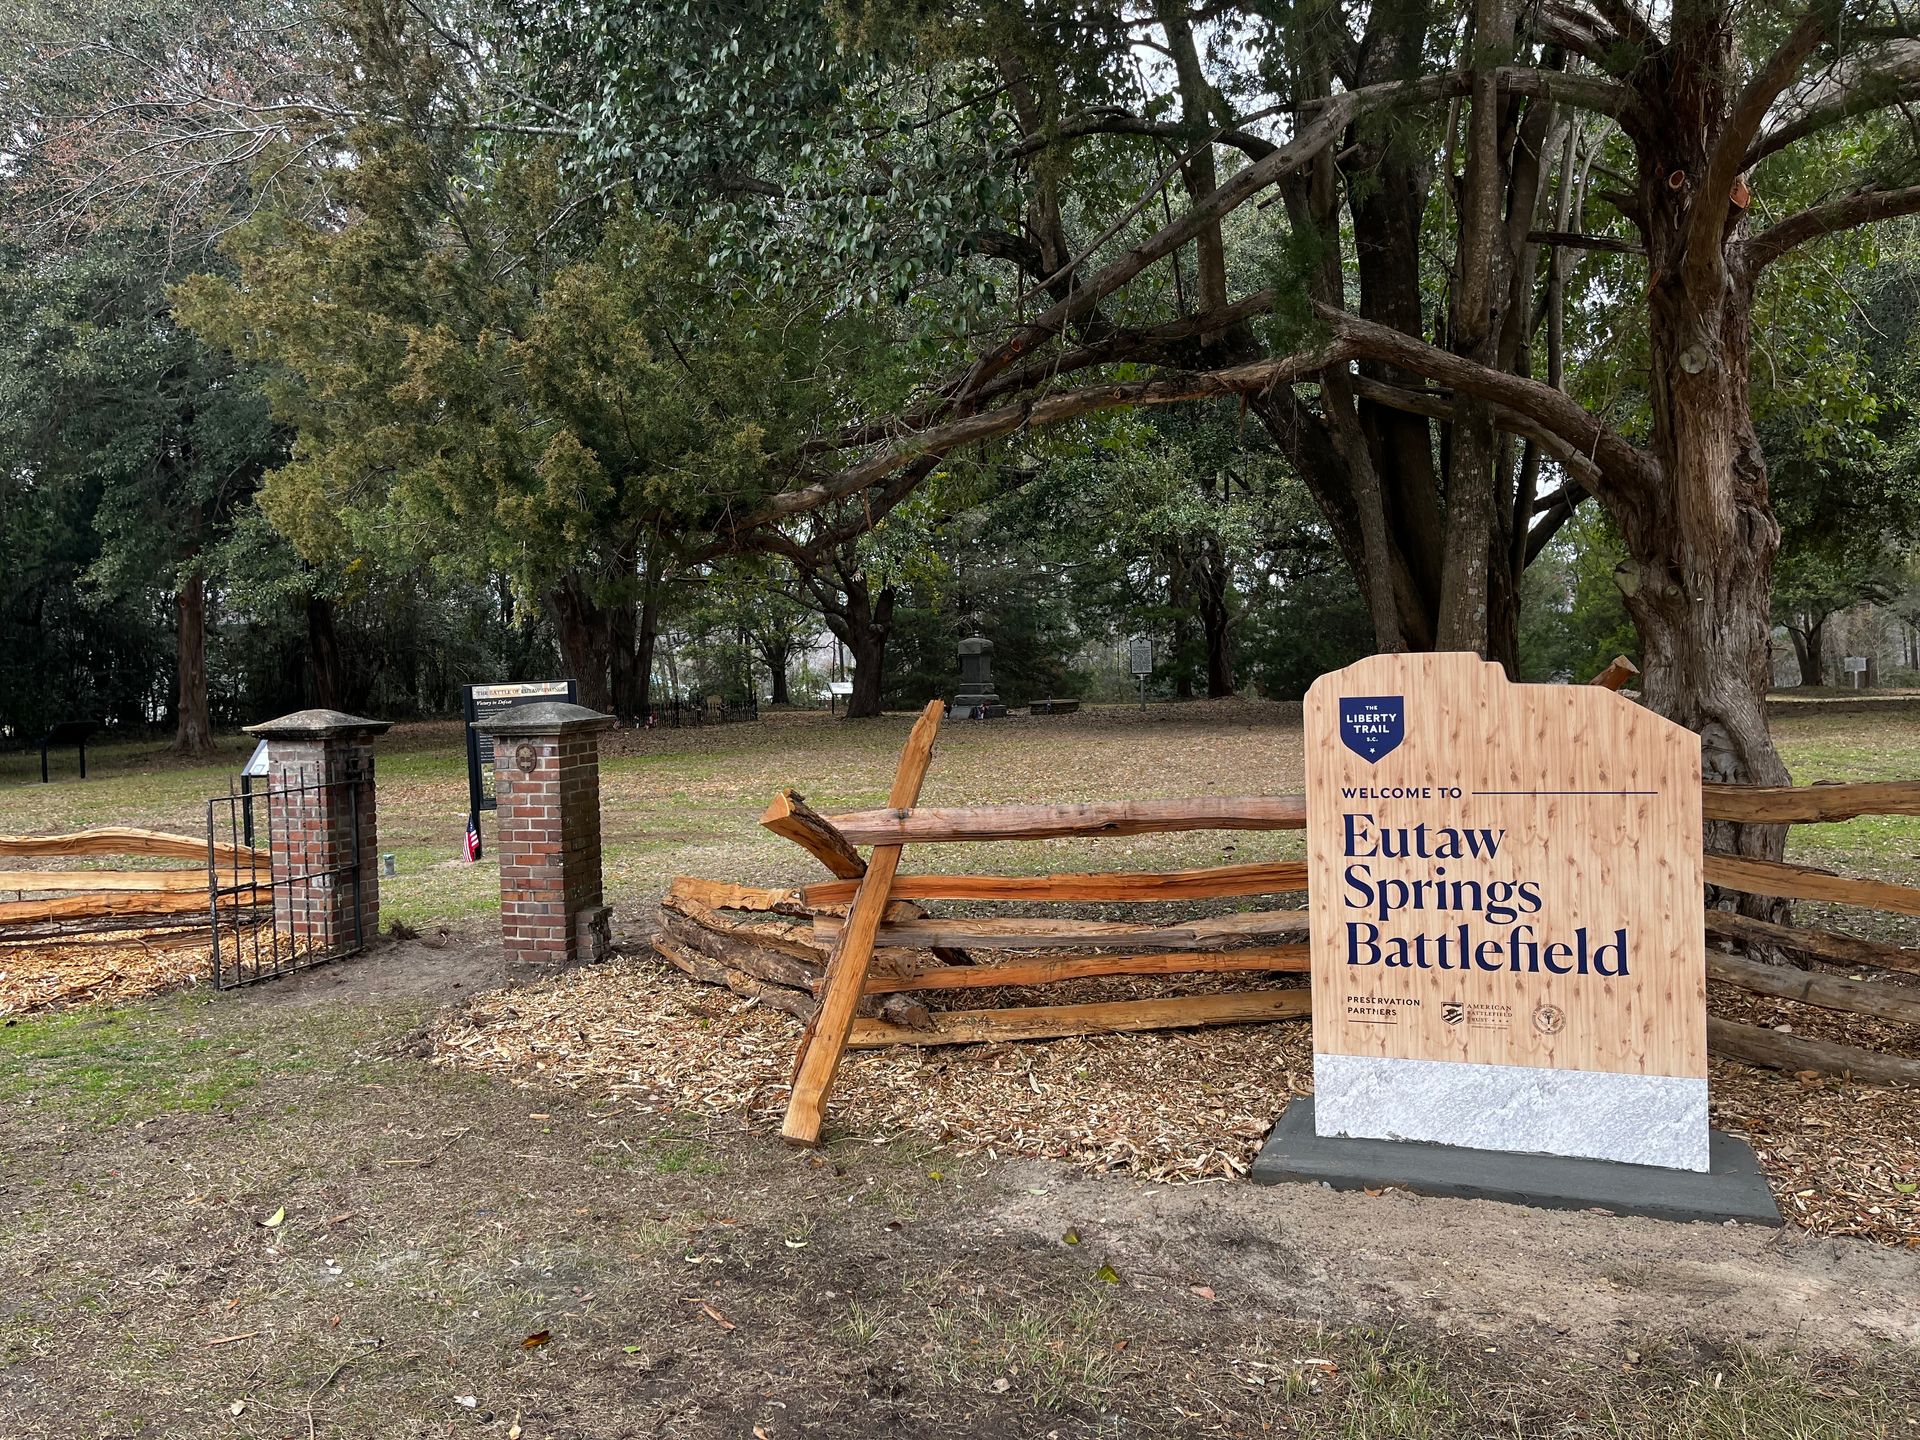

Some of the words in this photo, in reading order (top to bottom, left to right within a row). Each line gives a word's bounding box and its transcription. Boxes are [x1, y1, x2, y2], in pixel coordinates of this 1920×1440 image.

[1346, 713, 1397, 723] LIBERTY
[1353, 725, 1390, 733] TRAIL
[1341, 787, 1431, 799] WELCOME
[1438, 787, 1462, 799] TO
[1342, 813, 1506, 860] Eutaw
[1343, 864, 1543, 925] Springs
[1345, 921, 1631, 977] Battlefield
[1347, 996, 1421, 1006] PRESERVATION
[1347, 1007, 1397, 1016] PARTNERS
[1466, 1003, 1512, 1011] AMERICAN
[1466, 1010, 1513, 1018] BATTLEFIELD
